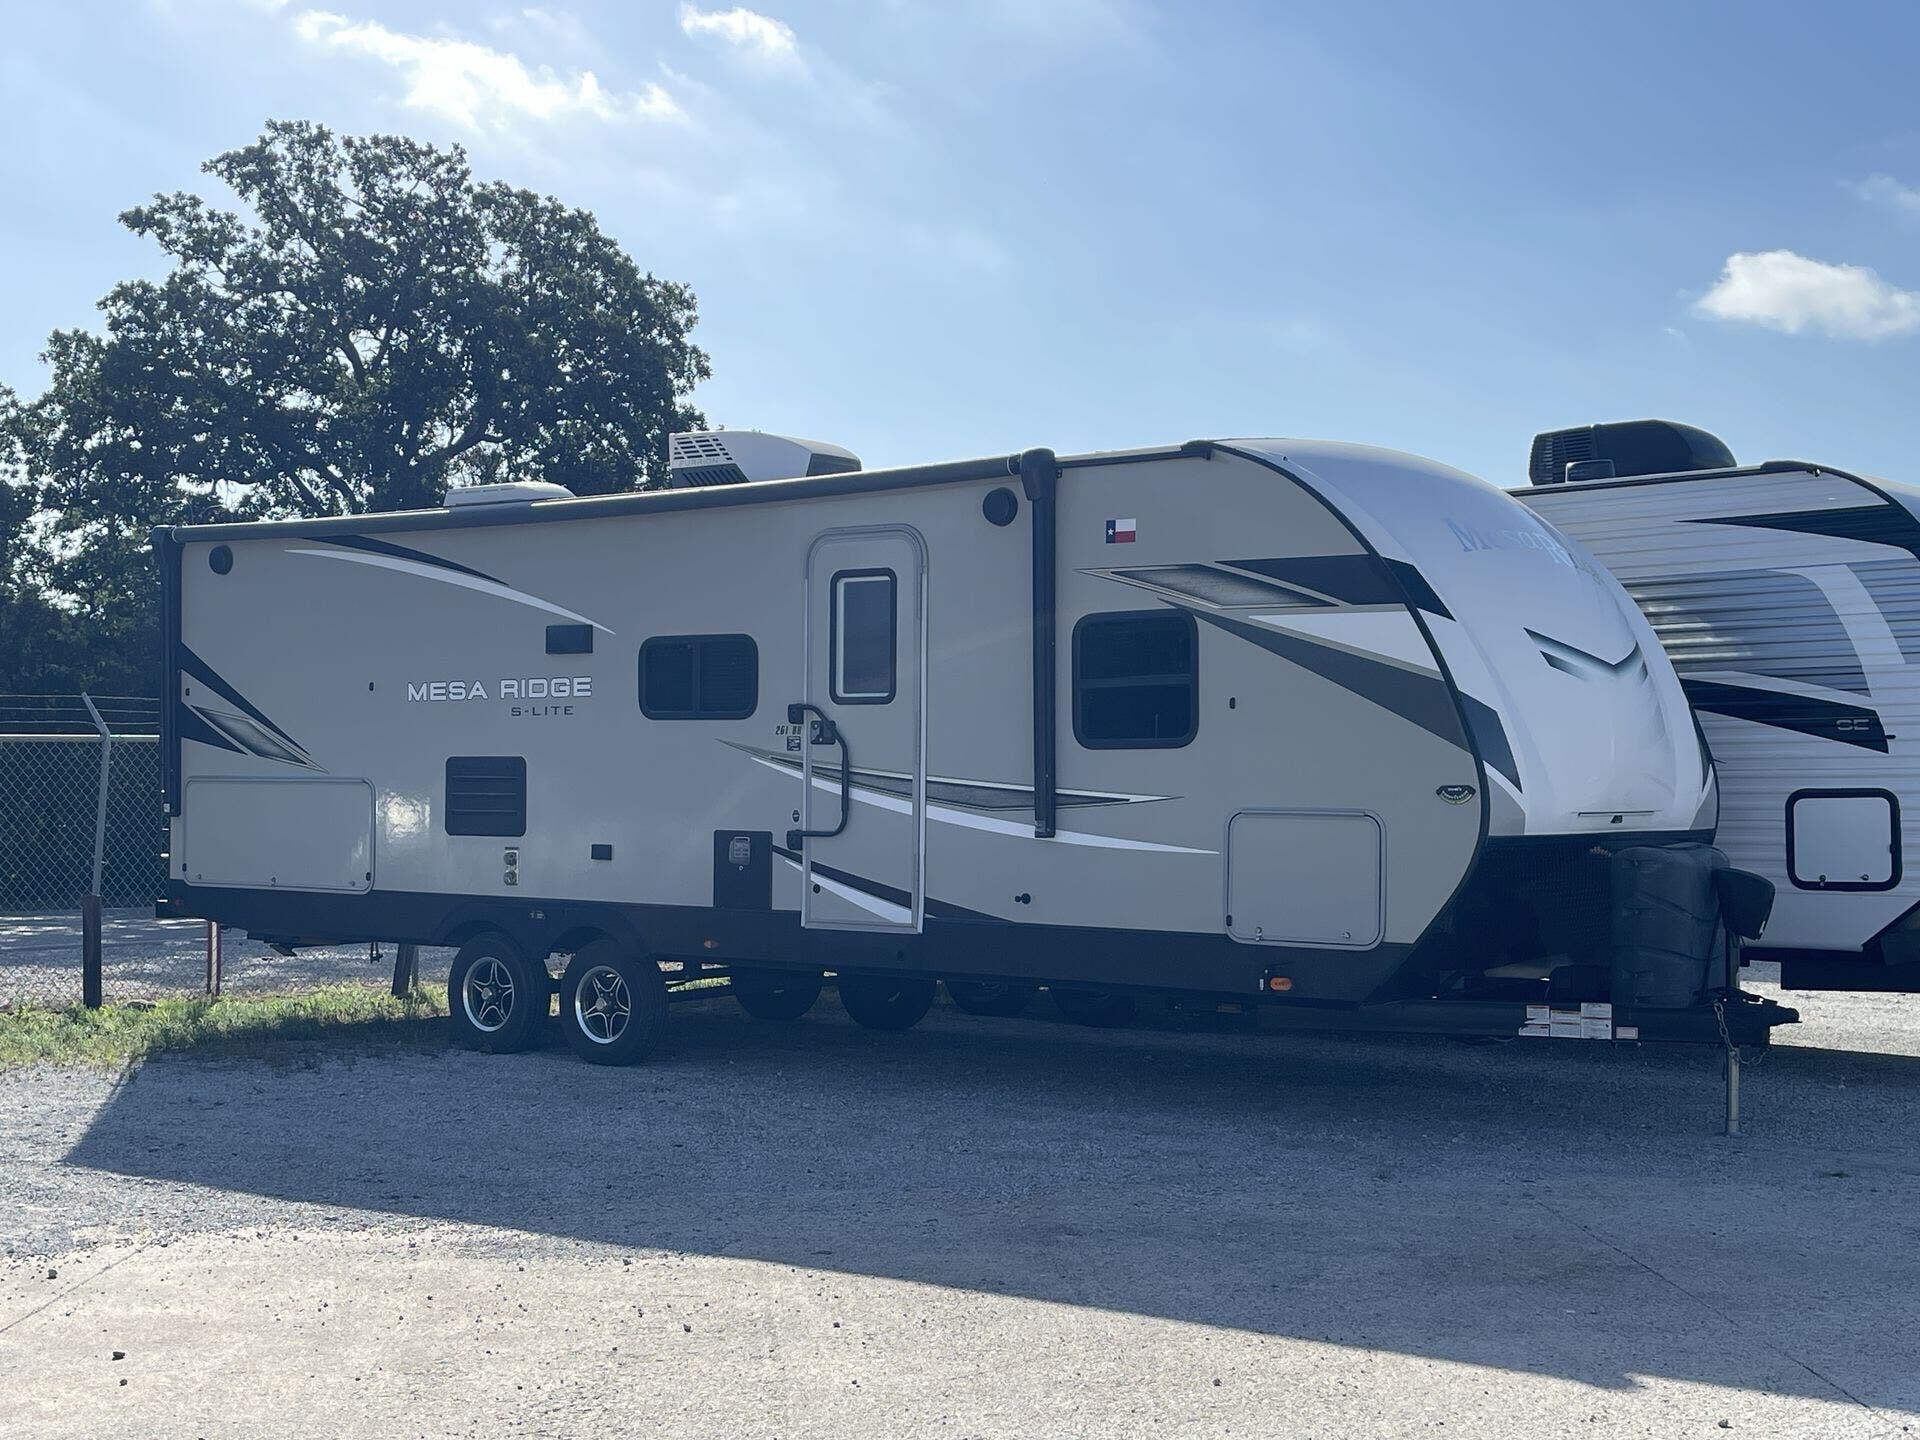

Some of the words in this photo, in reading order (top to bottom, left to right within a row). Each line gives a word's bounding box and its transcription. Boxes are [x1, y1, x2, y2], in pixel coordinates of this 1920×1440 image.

[408, 680, 489, 702] MESA
[500, 676, 592, 699] RIDGE
[511, 705, 574, 716] S-LITE
